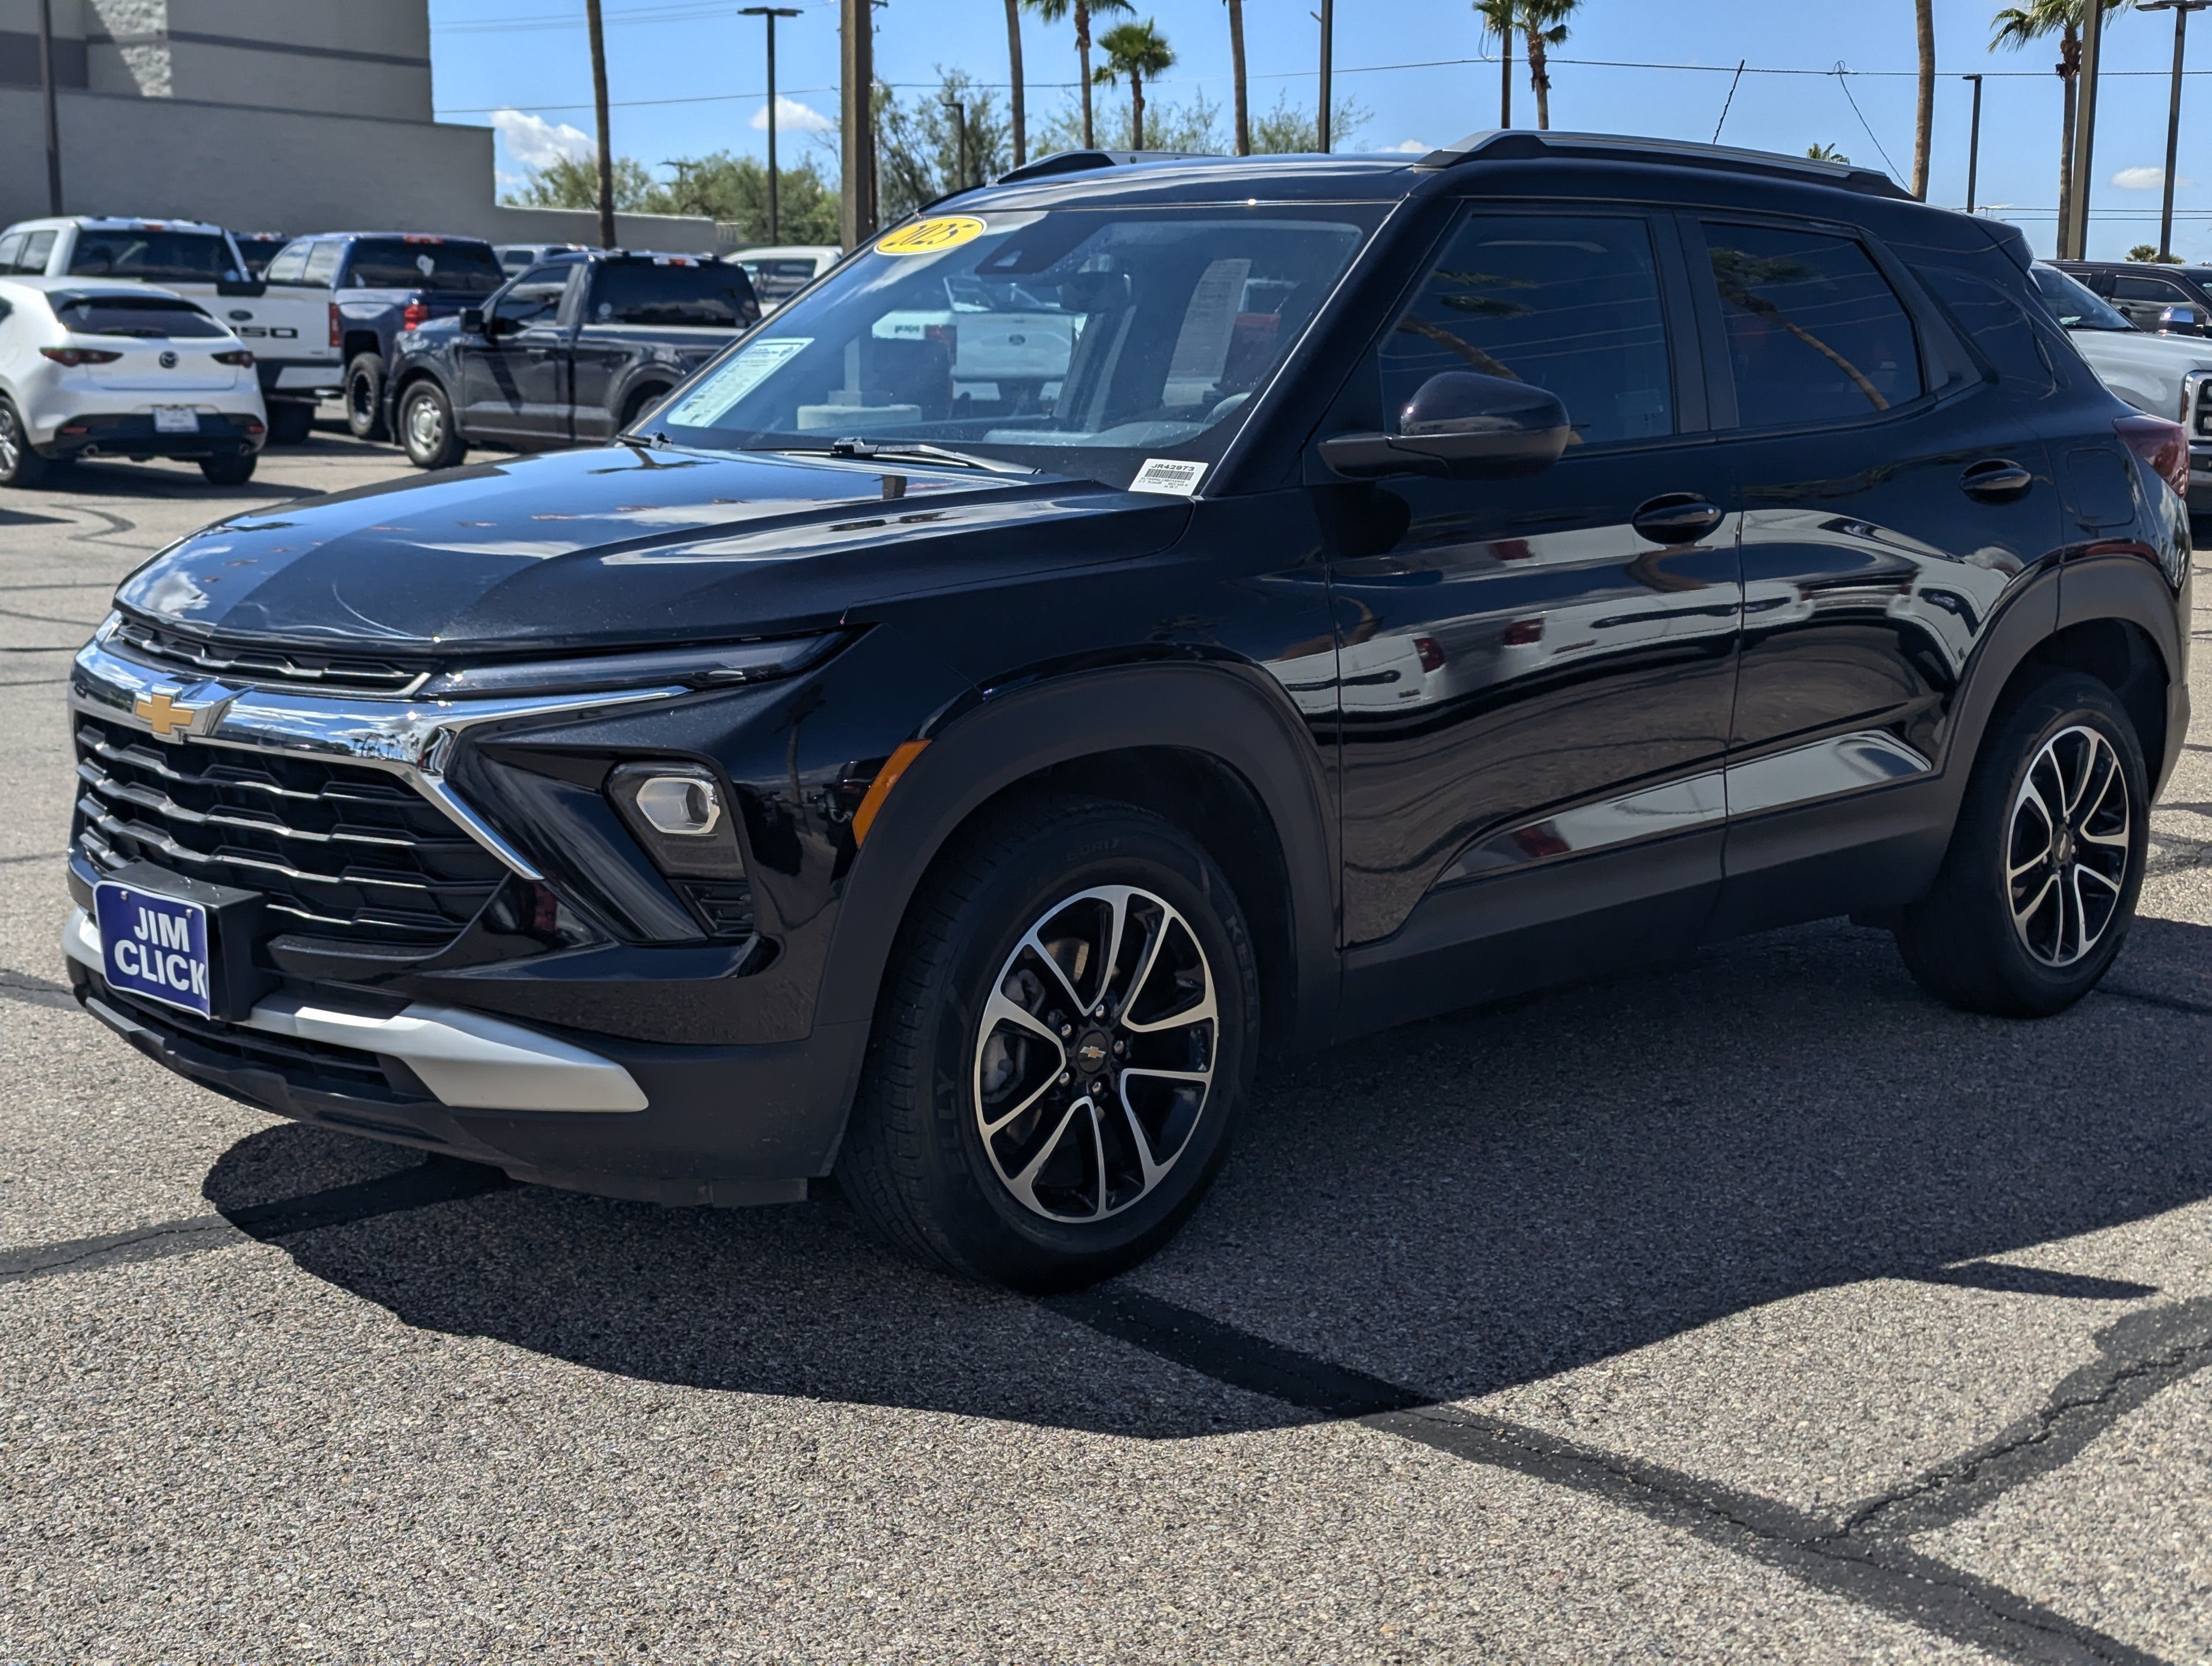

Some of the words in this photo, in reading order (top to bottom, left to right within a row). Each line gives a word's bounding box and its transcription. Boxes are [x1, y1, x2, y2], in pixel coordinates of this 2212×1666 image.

[883, 223, 976, 248] 2025
[133, 906, 190, 953] JIM
[114, 939, 208, 1000] CLICK
